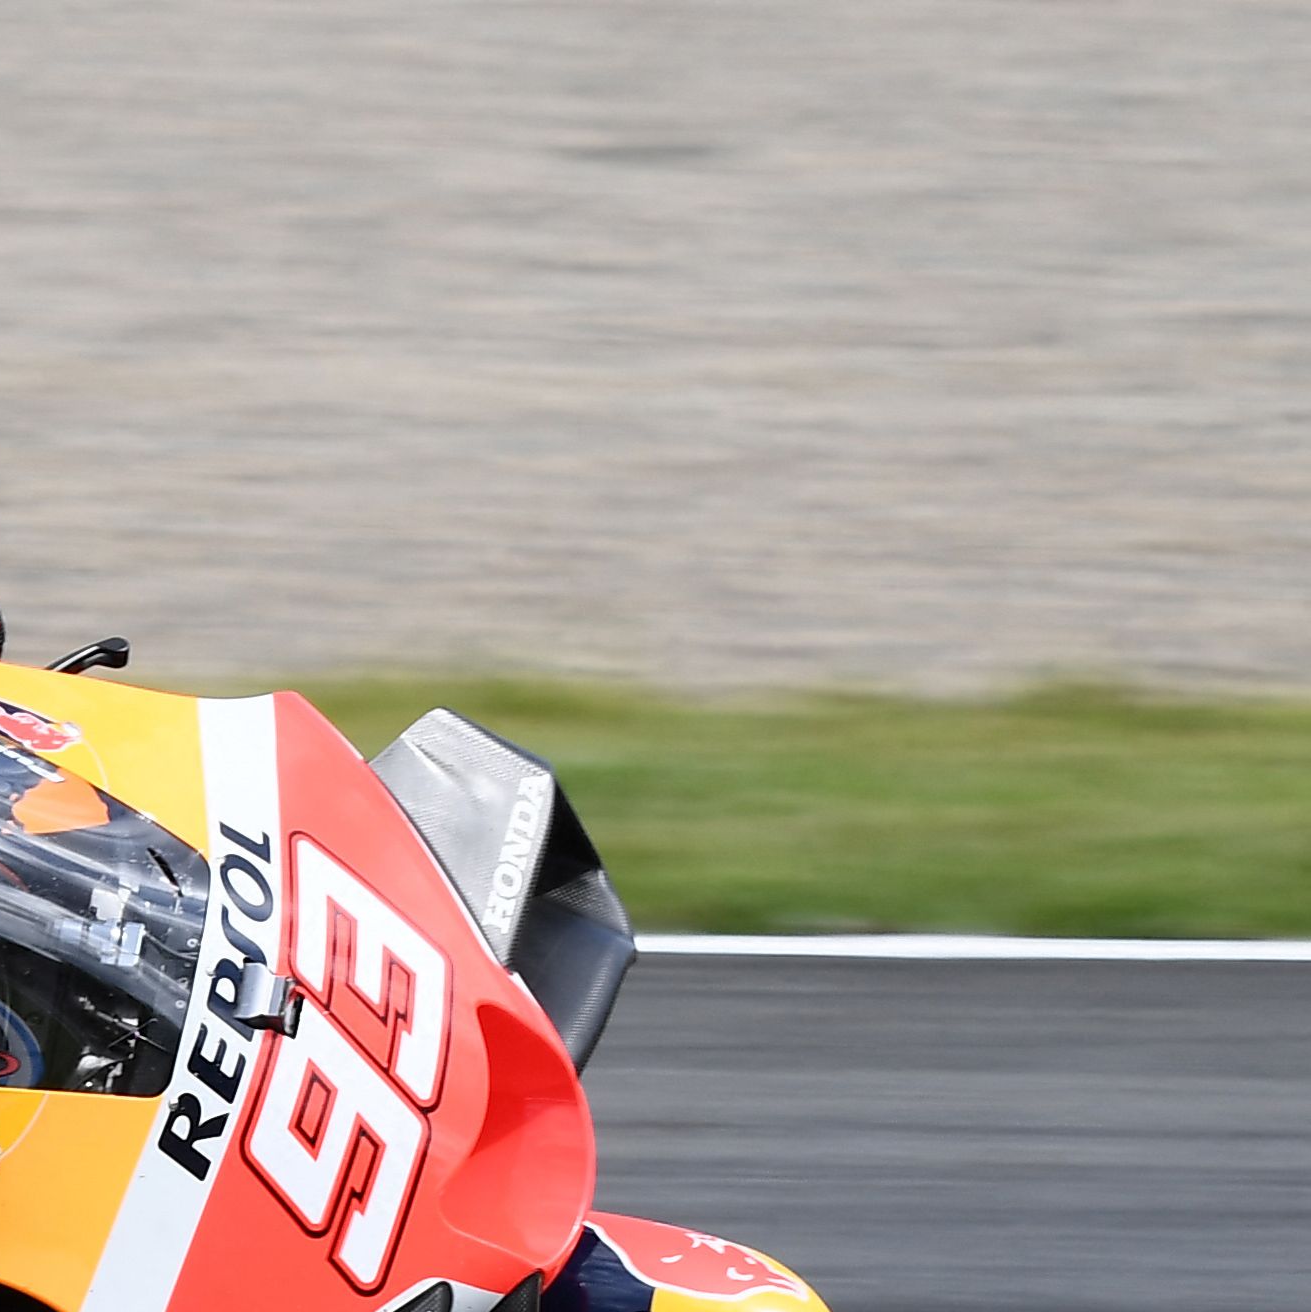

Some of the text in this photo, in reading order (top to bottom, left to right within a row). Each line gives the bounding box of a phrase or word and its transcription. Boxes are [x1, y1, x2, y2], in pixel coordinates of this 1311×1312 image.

[158, 821, 272, 1181] REPSOL
[481, 772, 554, 936] HONDA
[243, 833, 452, 1294] 93
